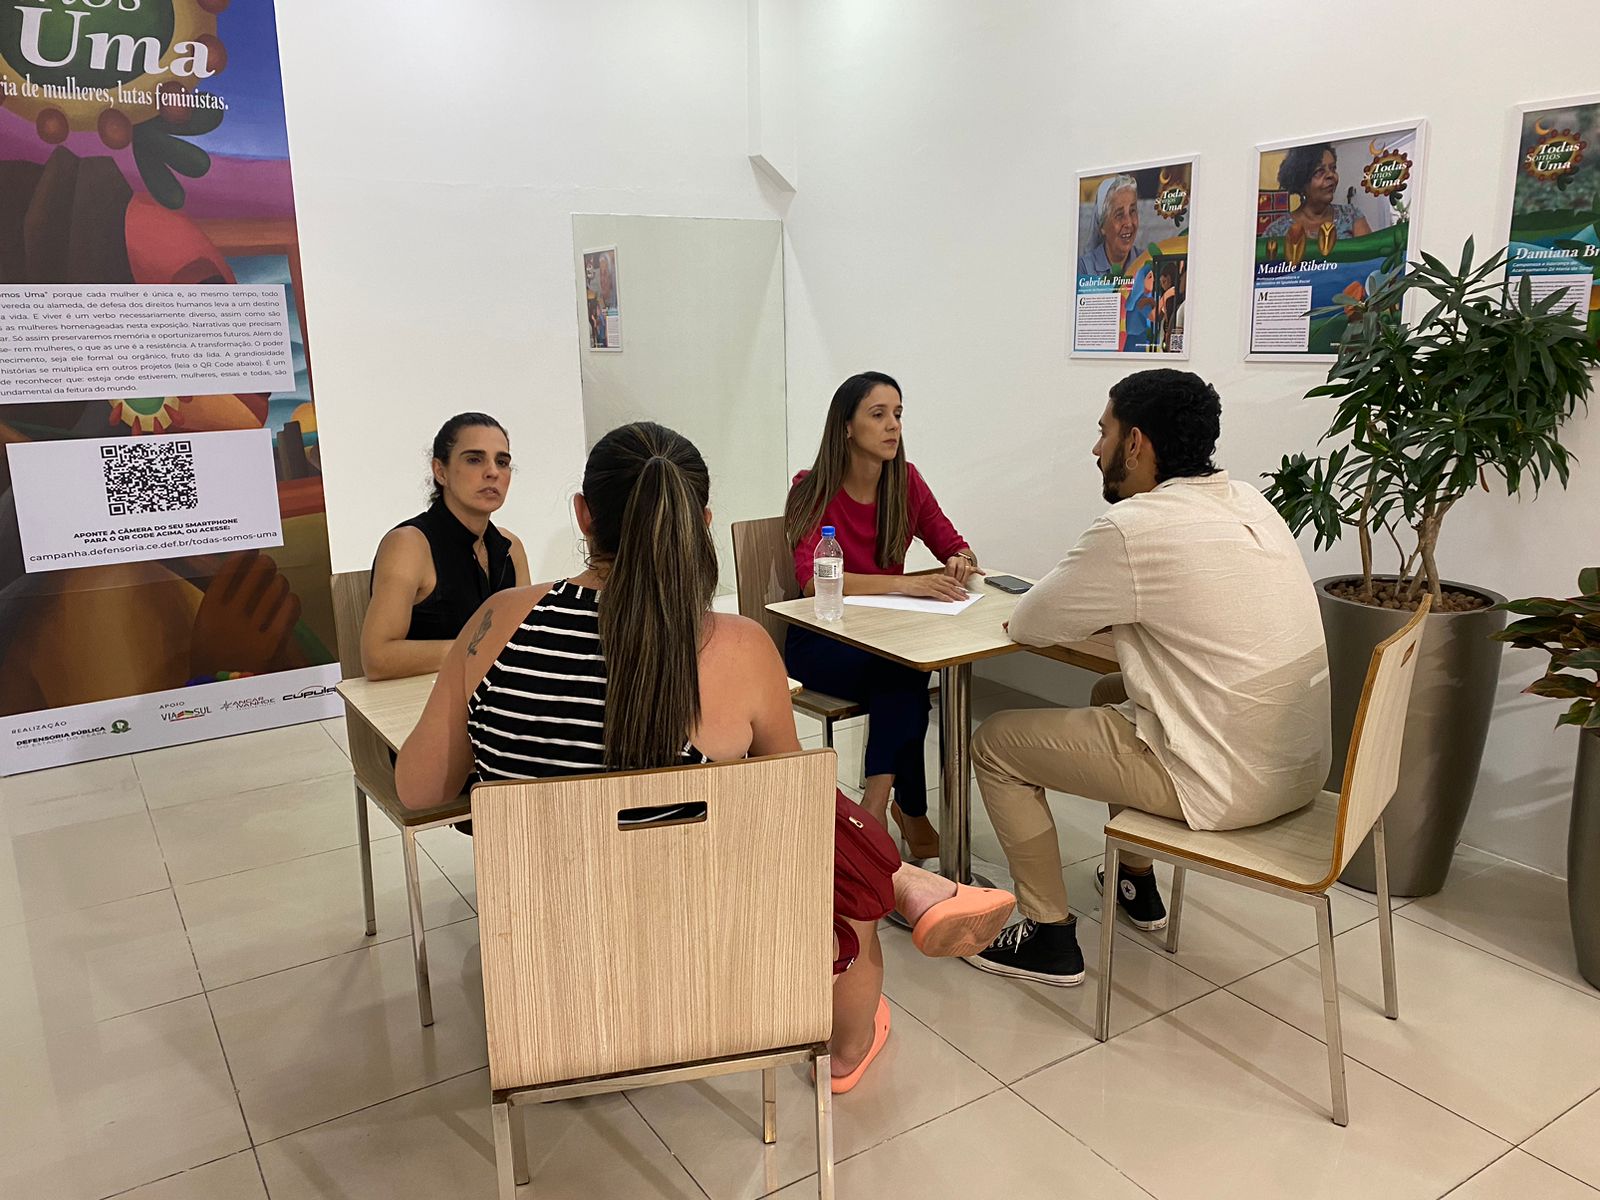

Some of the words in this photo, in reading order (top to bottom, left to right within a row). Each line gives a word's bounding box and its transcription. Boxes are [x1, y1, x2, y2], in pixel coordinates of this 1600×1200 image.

[14, 5, 216, 79] Uma
[21, 73, 39, 98] de
[43, 76, 114, 108] mulheres,
[117, 79, 152, 105] lutas
[155, 82, 229, 110] feministas.
[1538, 141, 1581, 155] Todas
[1524, 152, 1560, 162] Somos
[1374, 160, 1408, 172] Todas
[1537, 160, 1571, 172] Uma
[1372, 178, 1401, 188] Uma
[1514, 246, 1579, 260] Damiana
[1258, 260, 1296, 274] Matilde
[1299, 260, 1338, 272] Ribeiro
[1078, 276, 1110, 287] Gabriela
[1110, 276, 1135, 286] Pinna
[74, 530, 108, 538] APONTE
[118, 525, 152, 534] CÂMERA
[185, 518, 238, 528] SMARTPHONE
[156, 529, 184, 537] ACIMA,
[199, 525, 230, 533] ACESSE:
[29, 531, 278, 563] campanha.defensoria.ce.def.br/todas-somos-uma
[159, 702, 185, 710] APOIO
[161, 712, 177, 721] VIA
[194, 706, 212, 716] SUL
[12, 720, 67, 734] REALIZAÇÃO
[16, 732, 70, 746] DEFENSORIA
[71, 726, 106, 738] PÚBLICA
